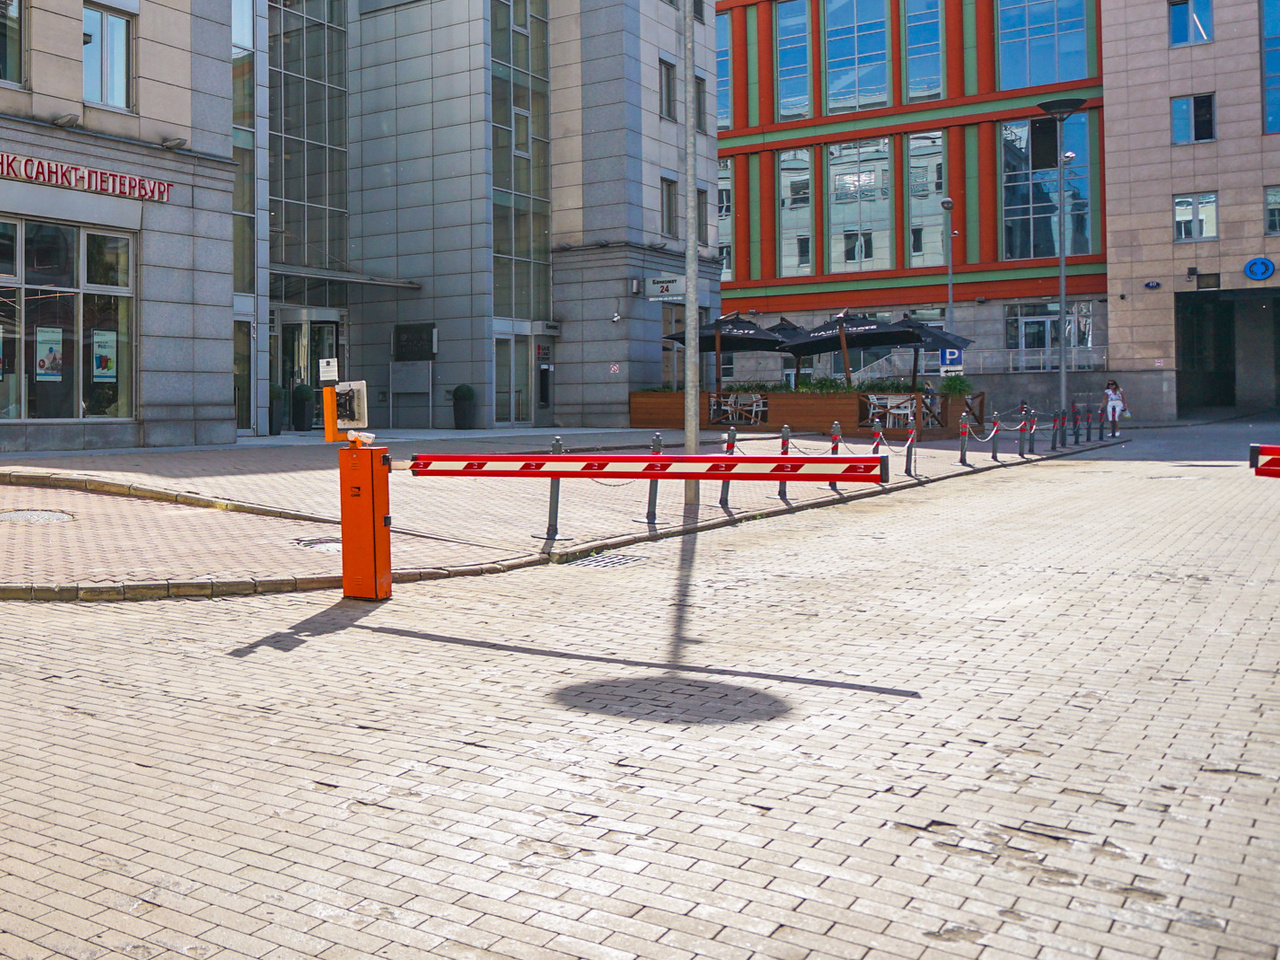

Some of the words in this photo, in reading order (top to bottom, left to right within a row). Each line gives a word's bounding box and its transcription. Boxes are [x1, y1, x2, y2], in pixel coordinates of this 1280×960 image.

[23, 158, 174, 202] САНКТ-ПЕТЕРБУРГ
[660, 285, 669, 293] 24
[946, 349, 959, 364] P
